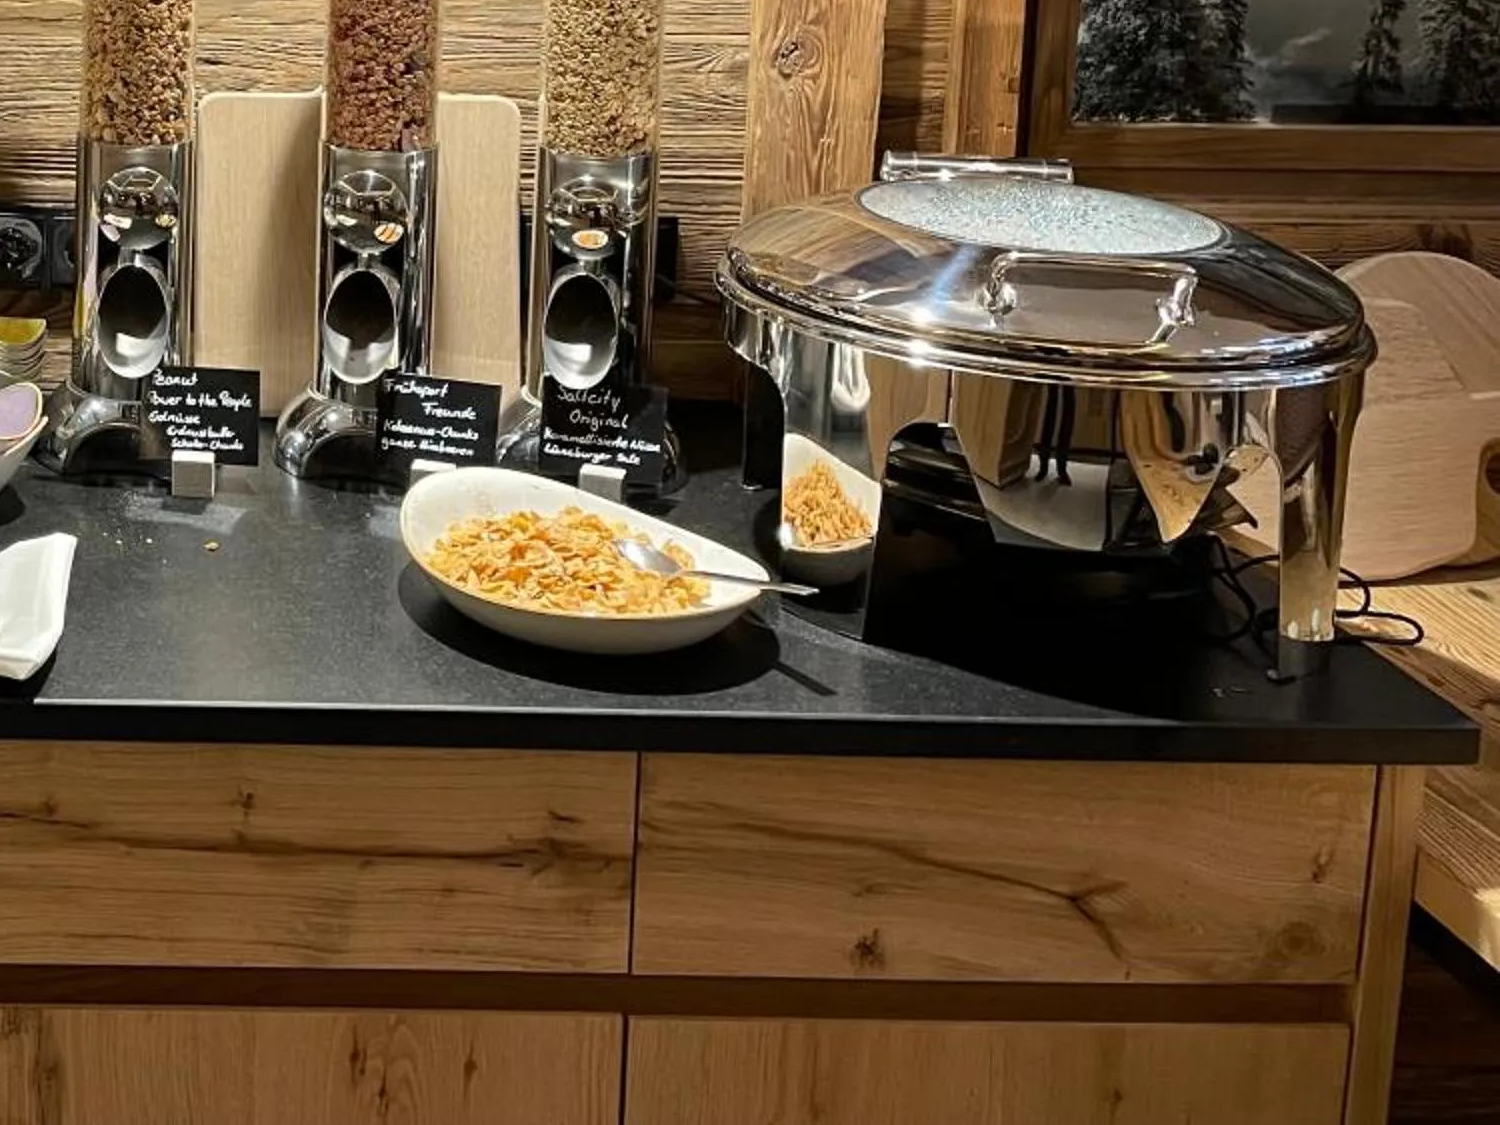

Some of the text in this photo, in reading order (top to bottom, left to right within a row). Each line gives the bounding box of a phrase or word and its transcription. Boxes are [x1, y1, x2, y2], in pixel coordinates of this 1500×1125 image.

[147, 390, 253, 412] Power to the People
[421, 401, 477, 421] Freunde
[569, 408, 630, 432] Original
